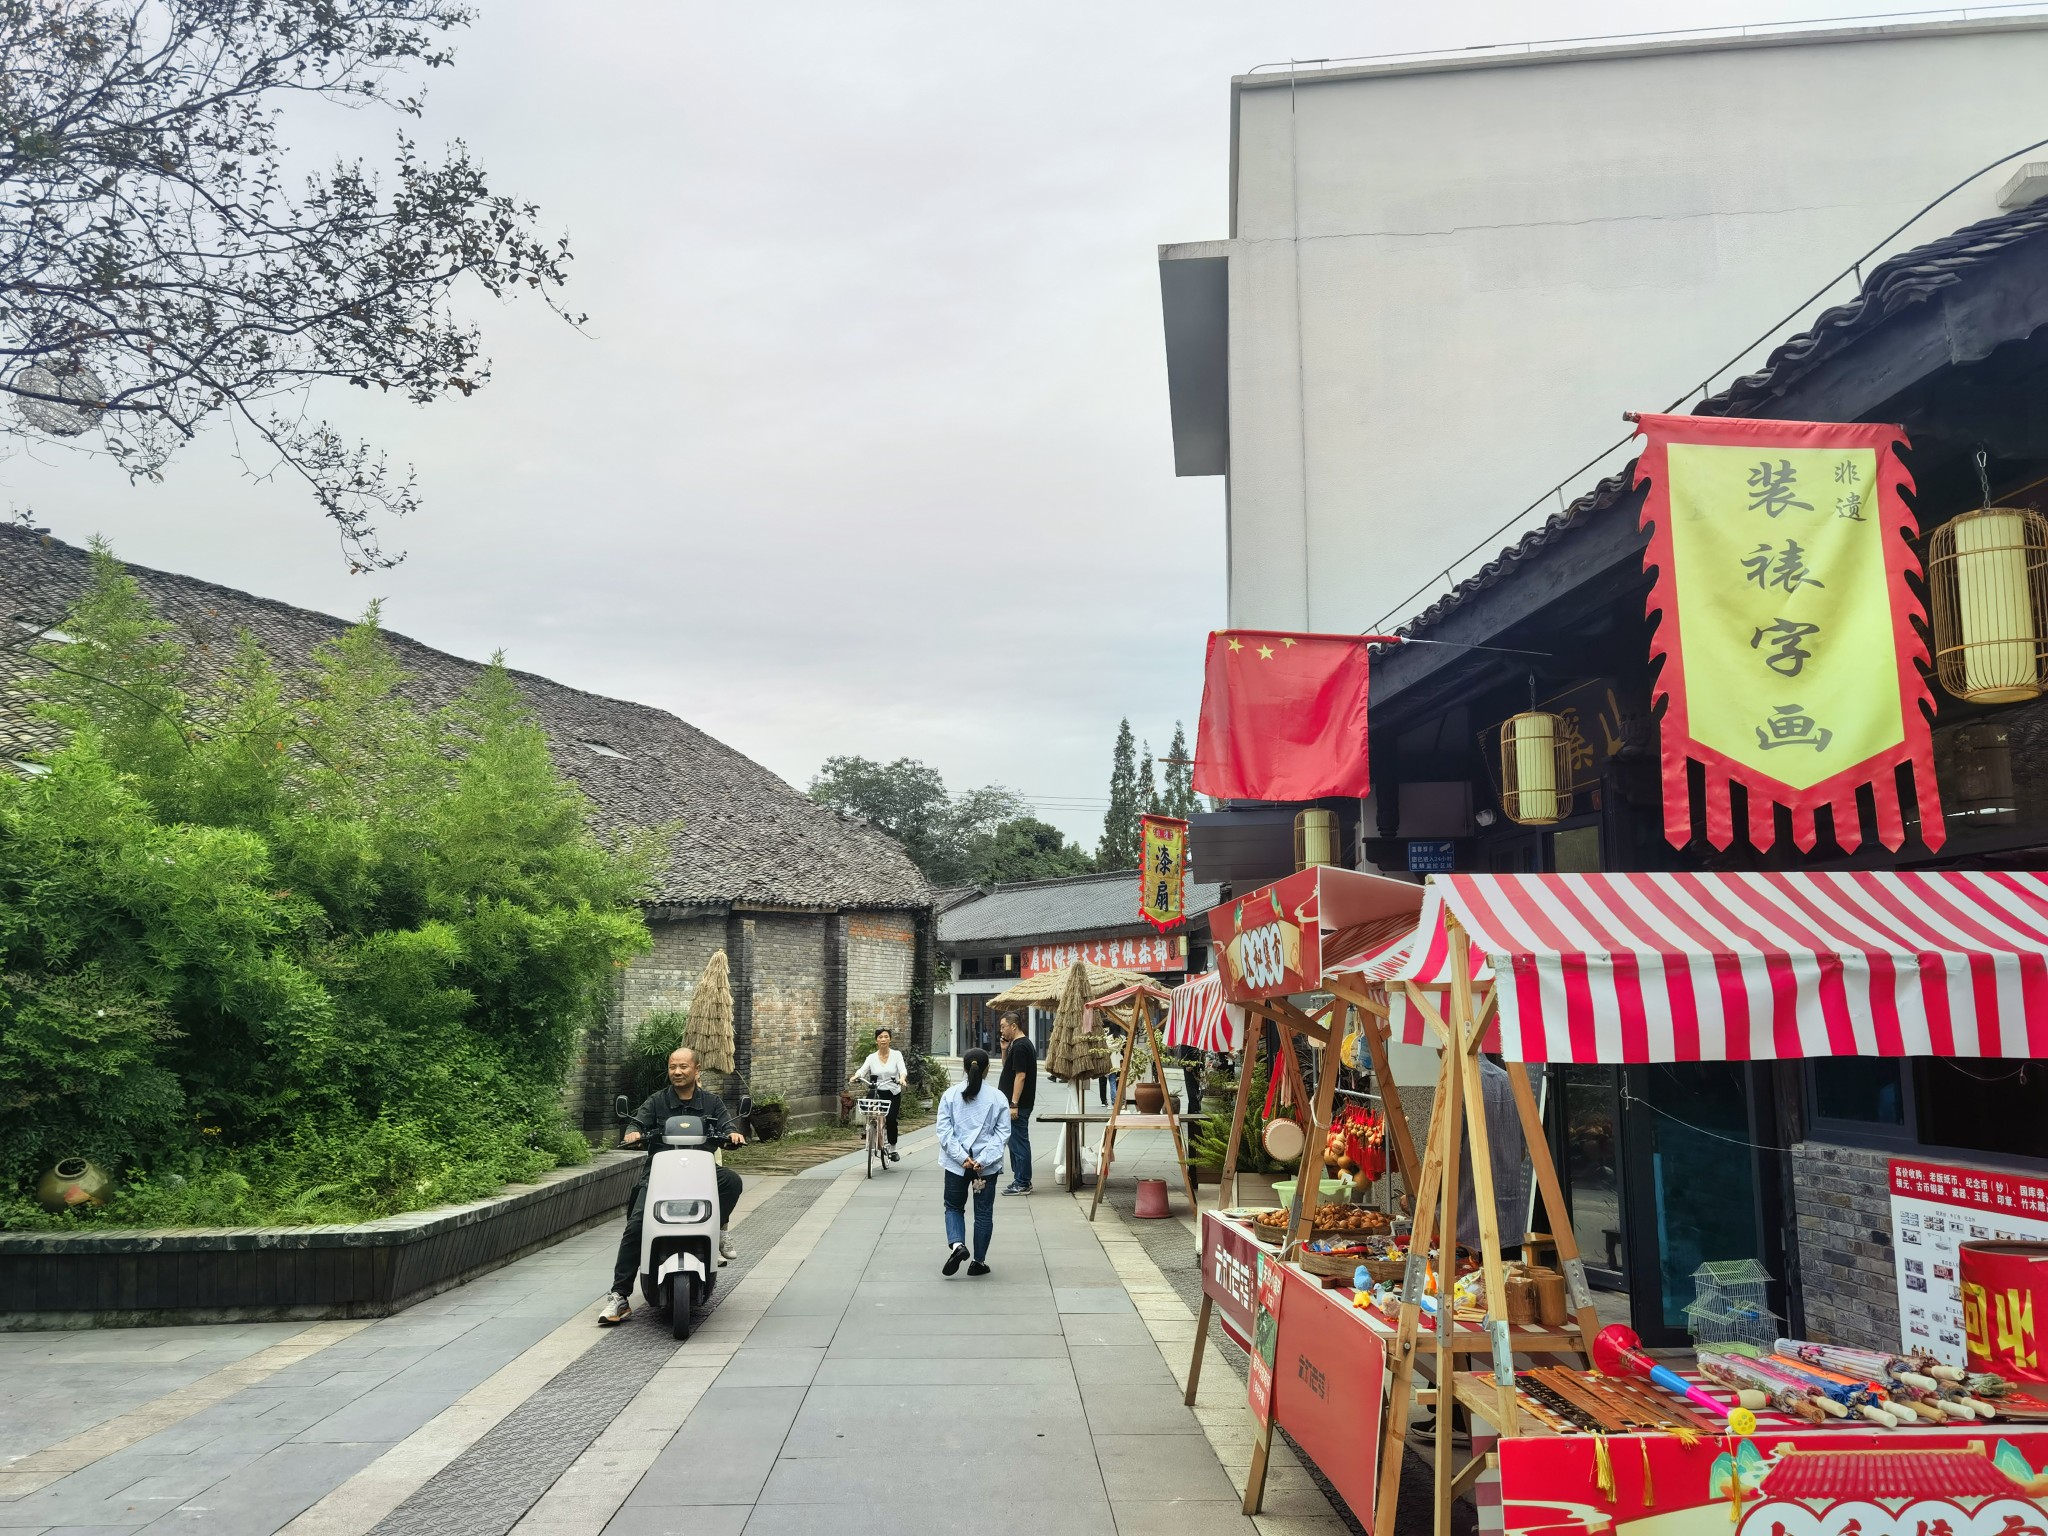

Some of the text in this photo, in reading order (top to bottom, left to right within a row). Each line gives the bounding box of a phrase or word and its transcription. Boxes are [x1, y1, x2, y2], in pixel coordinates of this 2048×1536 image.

[1834, 459, 1867, 521] 非遗
[1740, 459, 1833, 753] 装裱字画
[1154, 844, 1173, 912] 漆扇
